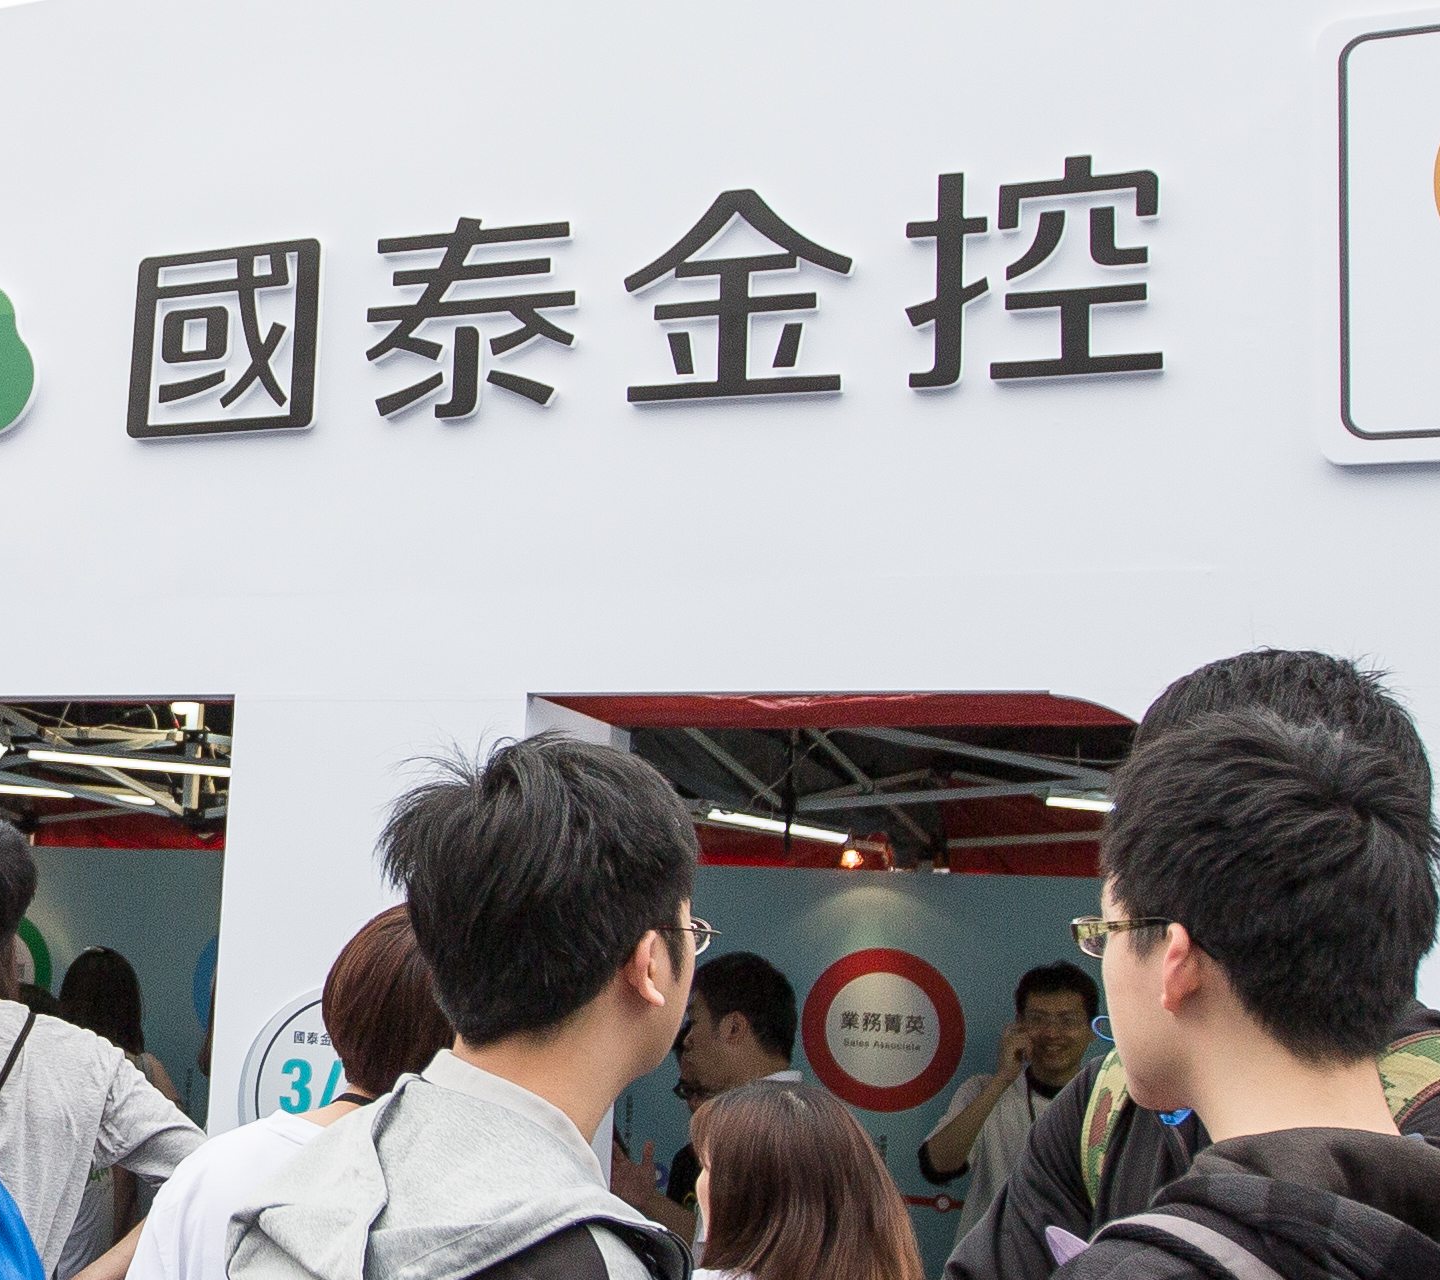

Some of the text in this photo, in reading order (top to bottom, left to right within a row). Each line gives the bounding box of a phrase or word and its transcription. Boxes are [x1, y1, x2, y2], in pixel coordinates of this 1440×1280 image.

[126, 154, 1165, 440] 國泰金控
[840, 1009, 926, 1036] 業務菁英
[293, 1030, 332, 1047] 國泰金
[843, 1038, 870, 1048] Sales
[278, 1057, 343, 1115] 3/
